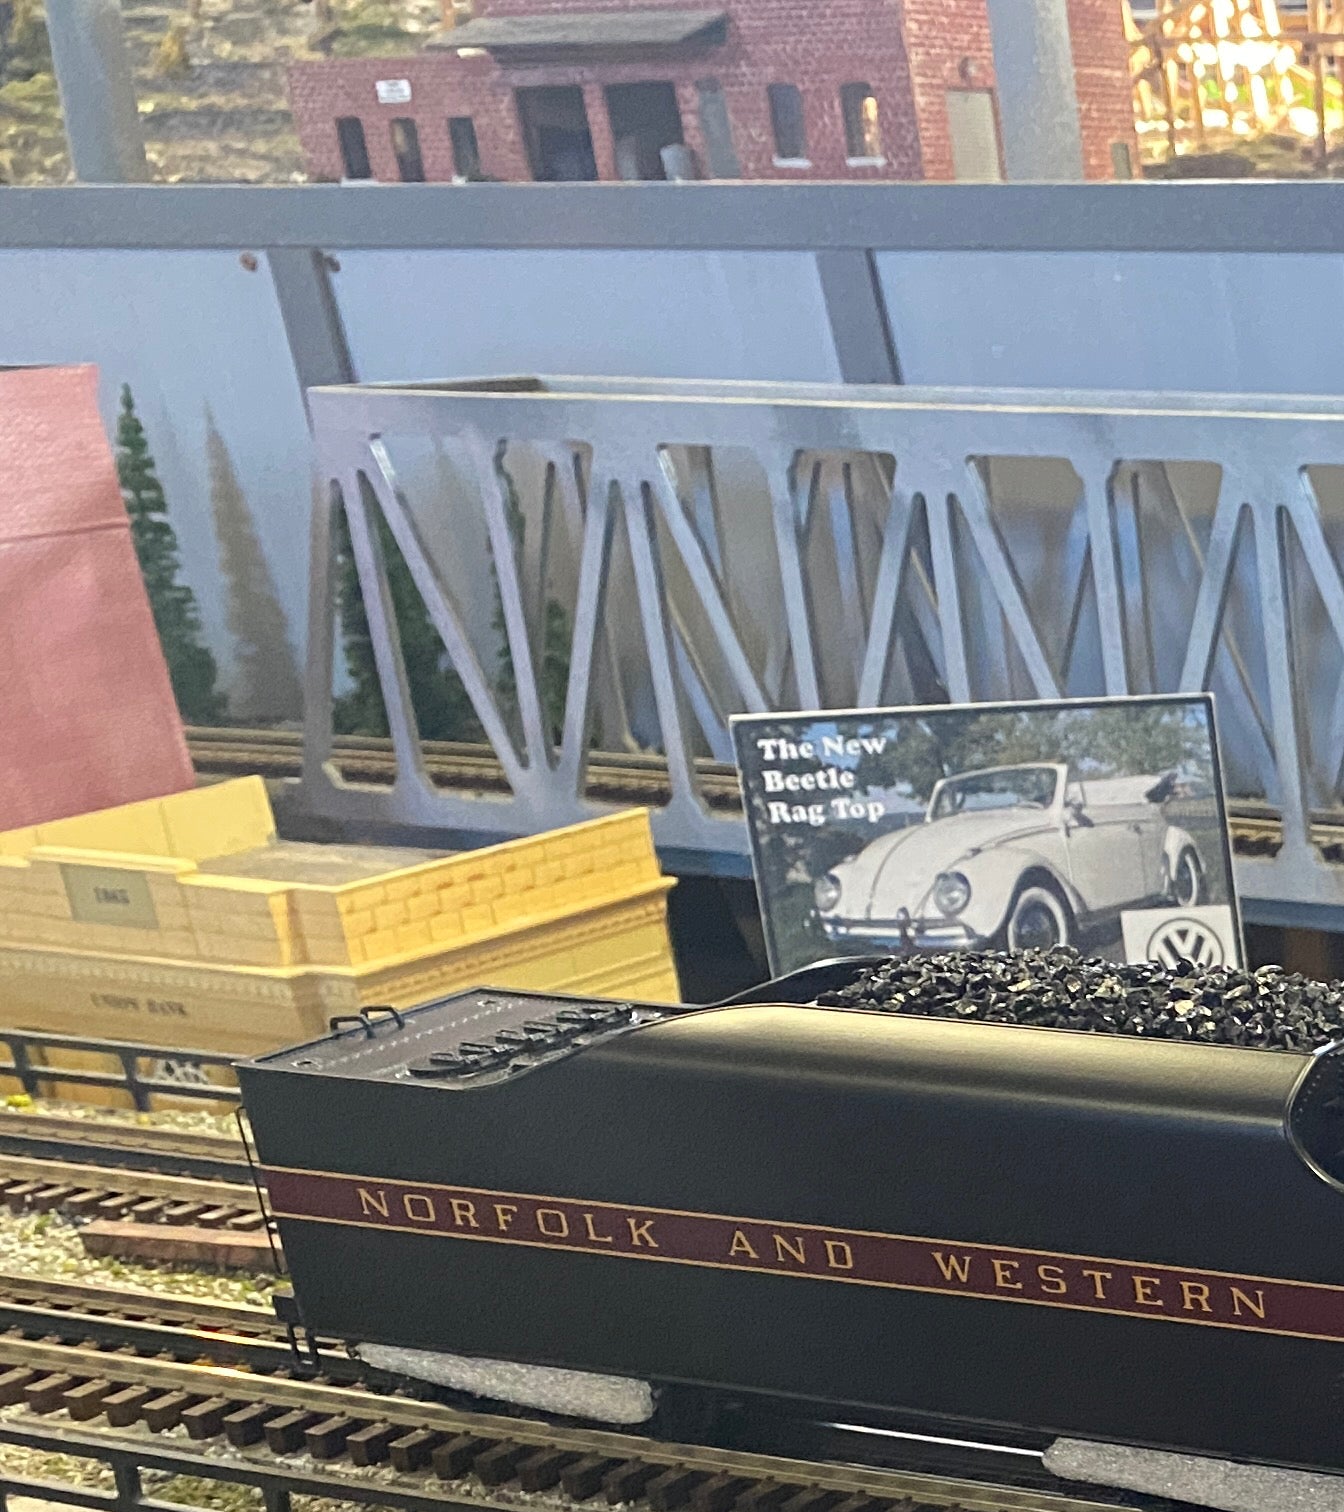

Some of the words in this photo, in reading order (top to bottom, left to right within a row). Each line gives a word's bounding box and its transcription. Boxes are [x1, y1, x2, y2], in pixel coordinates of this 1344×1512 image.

[757, 738, 814, 761] The
[821, 734, 887, 757] New
[761, 767, 855, 792] Beetle
[767, 801, 826, 827] Rag
[830, 797, 886, 823] Top
[357, 1187, 660, 1248] NORFOLK
[728, 1228, 854, 1269] AND
[931, 1251, 1266, 1319] WESTERN
